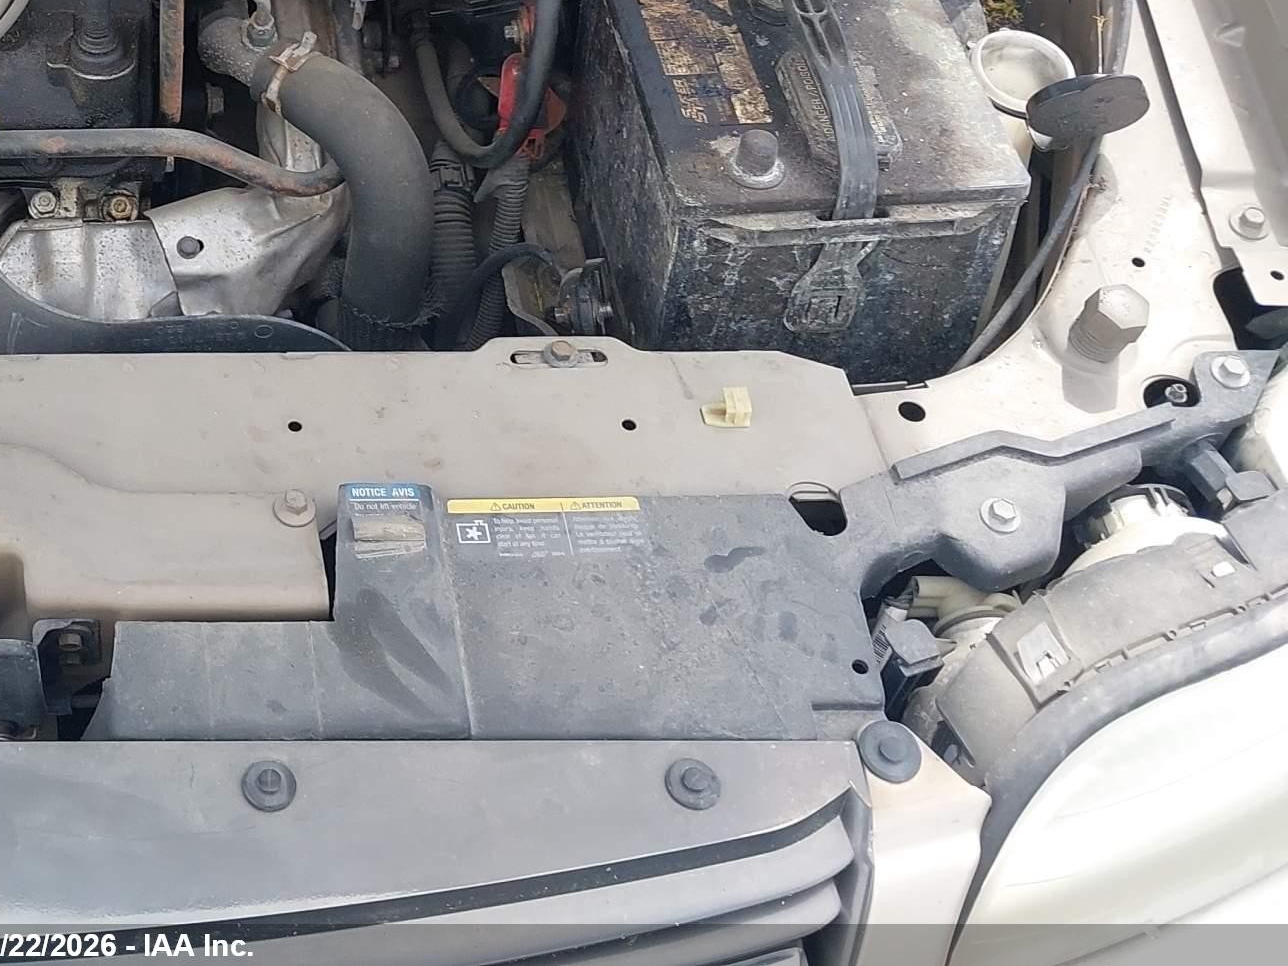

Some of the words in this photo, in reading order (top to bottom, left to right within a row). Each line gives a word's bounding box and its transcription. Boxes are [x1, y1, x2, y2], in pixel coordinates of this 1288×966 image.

[811, 96, 835, 135] DANGER
[351, 487, 387, 497] NOTICE
[392, 487, 415, 497] AVIS
[502, 503, 535, 511] CAUTION
[581, 501, 623, 509] ATTENTION
